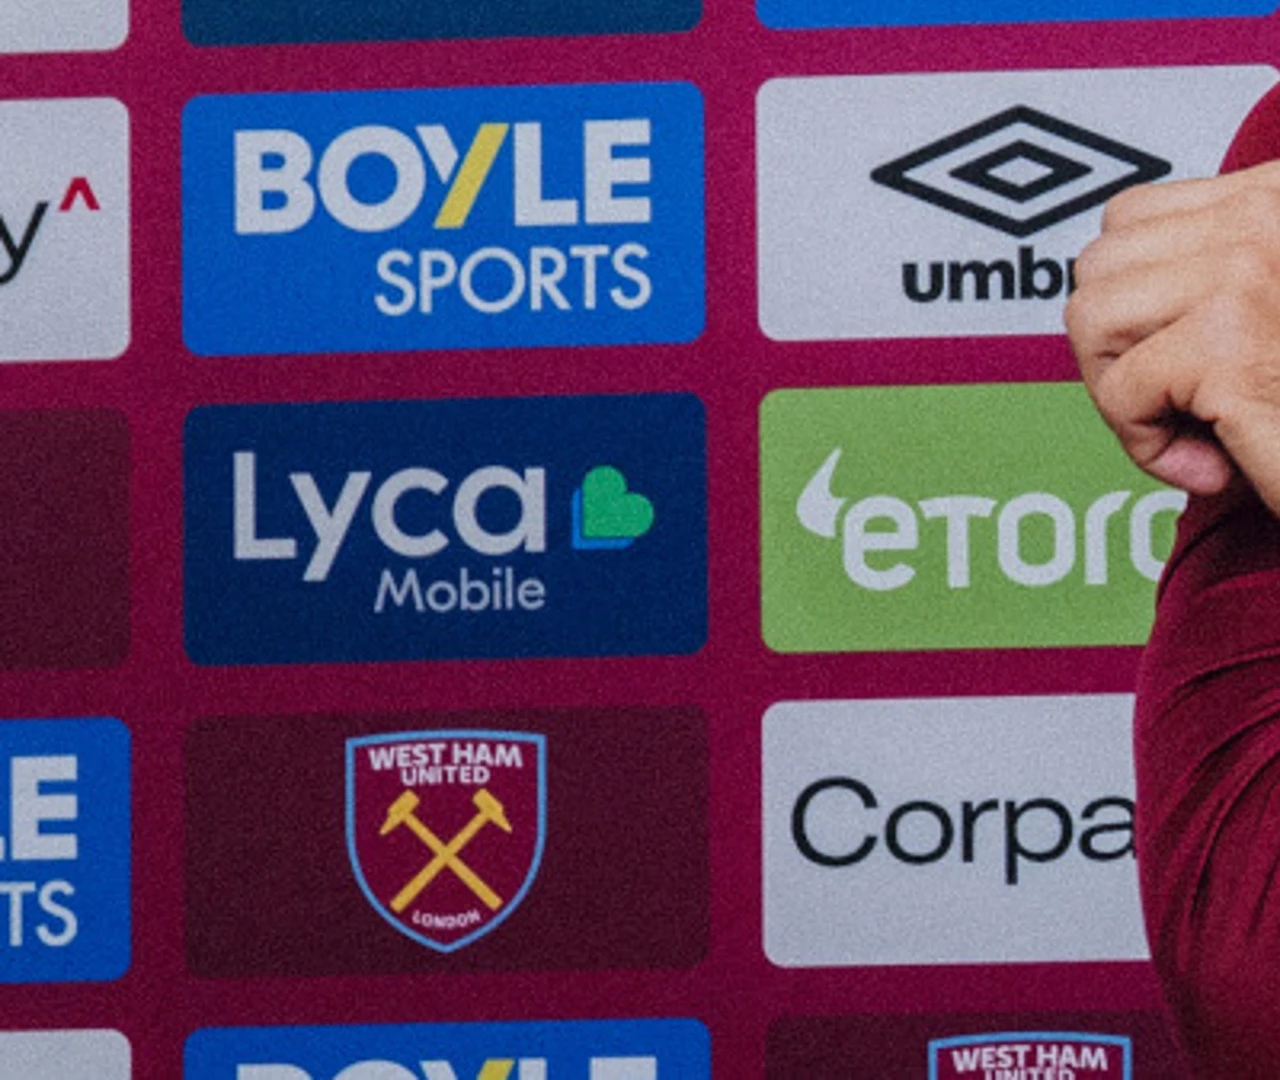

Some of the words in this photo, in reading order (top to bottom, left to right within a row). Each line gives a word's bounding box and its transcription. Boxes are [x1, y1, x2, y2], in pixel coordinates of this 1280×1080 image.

[233, 119, 652, 235] BOYLE
[374, 243, 652, 316] SPORTS
[901, 246, 1078, 303] umb
[231, 451, 546, 583] Lyca
[373, 565, 546, 614] Mobile
[367, 743, 447, 771] WEST
[450, 742, 523, 769] HAM
[400, 765, 490, 786] UNITED
[791, 777, 1137, 886] Corpa
[410, 908, 482, 931] LONDON
[952, 1045, 1030, 1072] WEST
[1036, 1044, 1108, 1071] HAM
